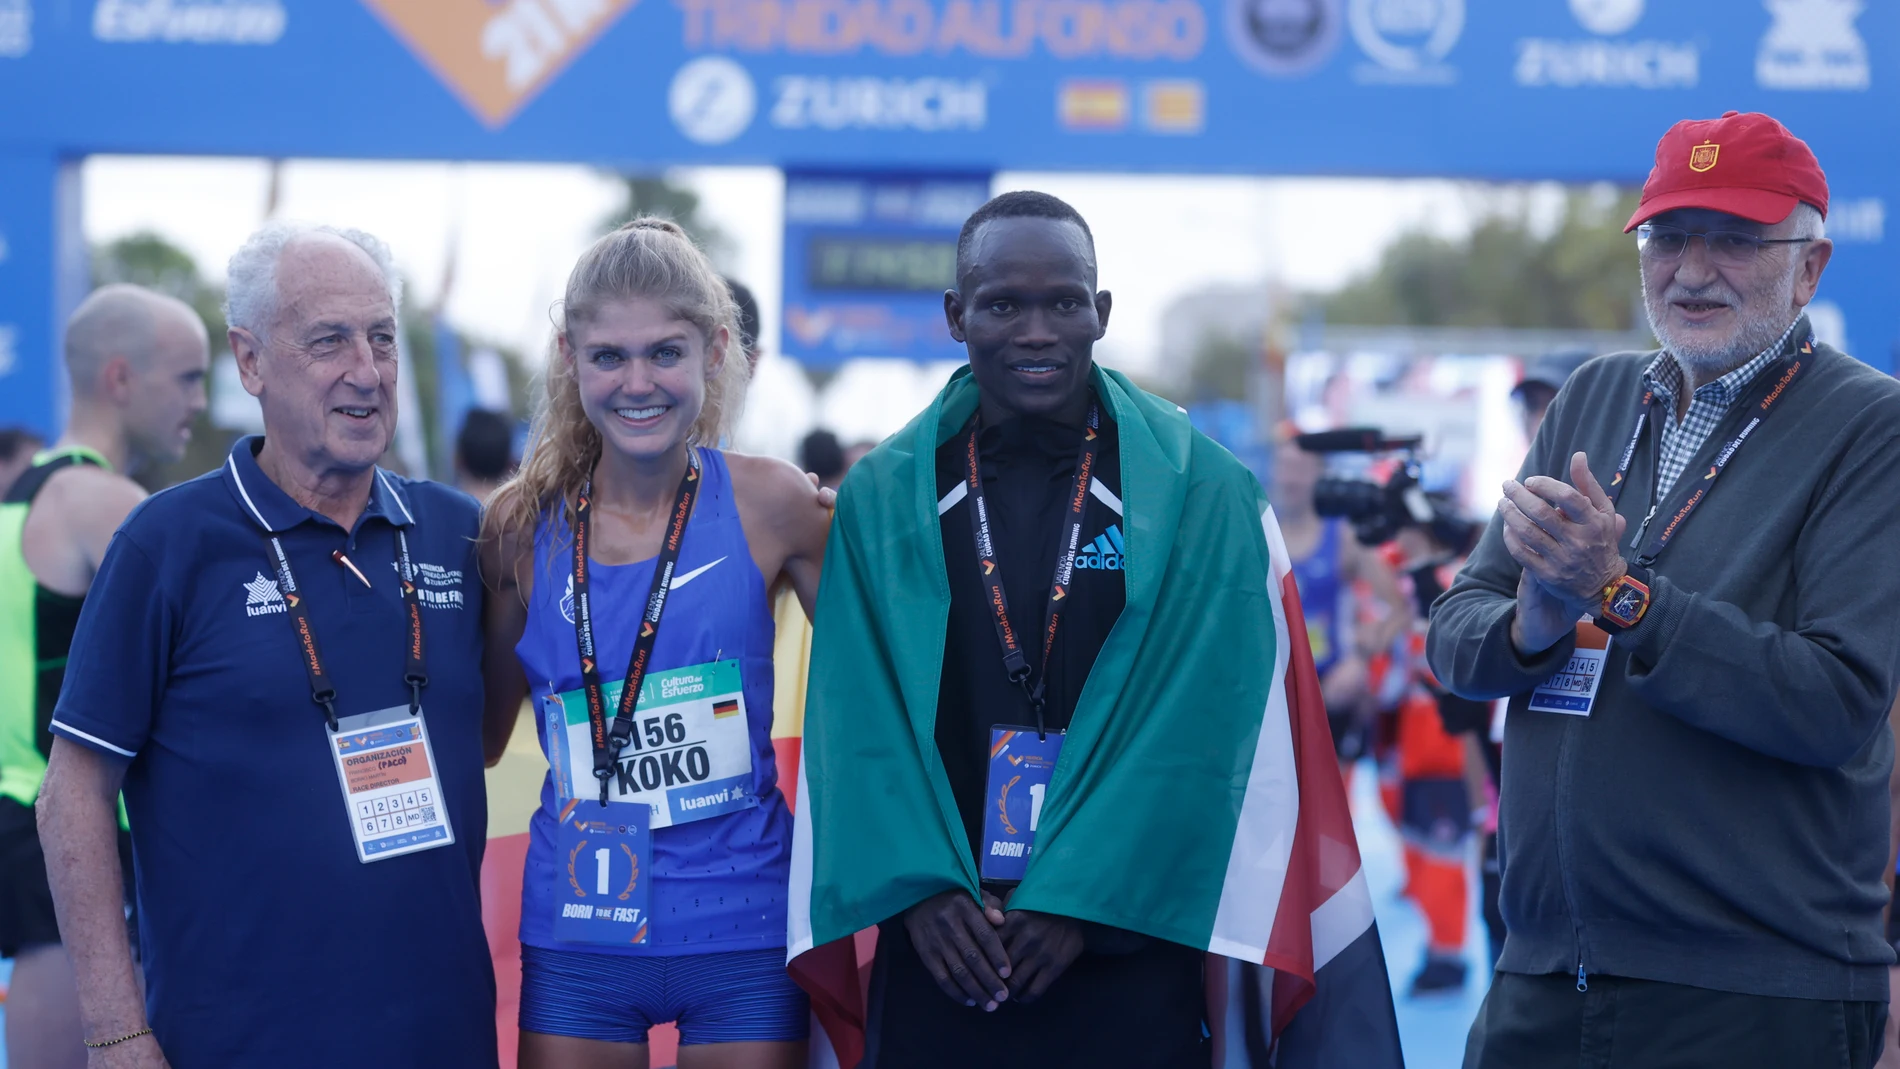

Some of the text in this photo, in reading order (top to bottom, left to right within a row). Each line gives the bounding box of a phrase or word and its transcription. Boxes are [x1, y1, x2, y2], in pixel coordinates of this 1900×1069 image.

[1516, 38, 1699, 88] ZURICH
[769, 75, 987, 130] ZURICH
[1761, 361, 1801, 410] #MadeToRun
[967, 431, 979, 489] #MadeToRun
[1718, 417, 1760, 467] CIUDAD DEL RUNNING
[1072, 452, 1092, 513] #MadeToRun
[668, 492, 691, 552] #MadeToRun
[976, 496, 993, 557] CIUDAD DEL RUNNING
[1661, 489, 1703, 541] #MadeToRun
[576, 521, 585, 583] #MadeToRun
[1062, 523, 1080, 585] CIUDAD DEL RUNNING
[1074, 552, 1124, 570] adid
[246, 601, 288, 617] luanvi
[651, 561, 674, 622] CIUDAD DEL RUNNING
[411, 603, 421, 660] #MadeToRun
[992, 585, 1016, 650] #MadeToRun
[298, 617, 321, 676] #MadeToRun
[1570, 661, 1595, 672] 3 4 5
[623, 649, 646, 713] #MadeToRun
[661, 675, 693, 689] Cultura
[661, 683, 704, 698] Esfuerzo
[1555, 677, 1561, 686] 7
[1564, 678, 1570, 687] 8
[590, 684, 605, 749] #MadeToRun
[629, 713, 686, 750] 156
[346, 747, 412, 766] ORGANIZACIÓN
[378, 756, 407, 770] (PACO)
[617, 746, 710, 796] KOKO
[352, 778, 400, 793] RACE DIRECTOR
[363, 793, 428, 815] 1 2 3 4 5
[680, 791, 729, 811] luanvi
[1030, 783, 1046, 831] 1
[366, 812, 420, 831] 6 7 8 MD
[595, 848, 610, 895] 1
[990, 841, 1025, 858] BORN
[562, 903, 640, 923] BORN TO BE FAST
